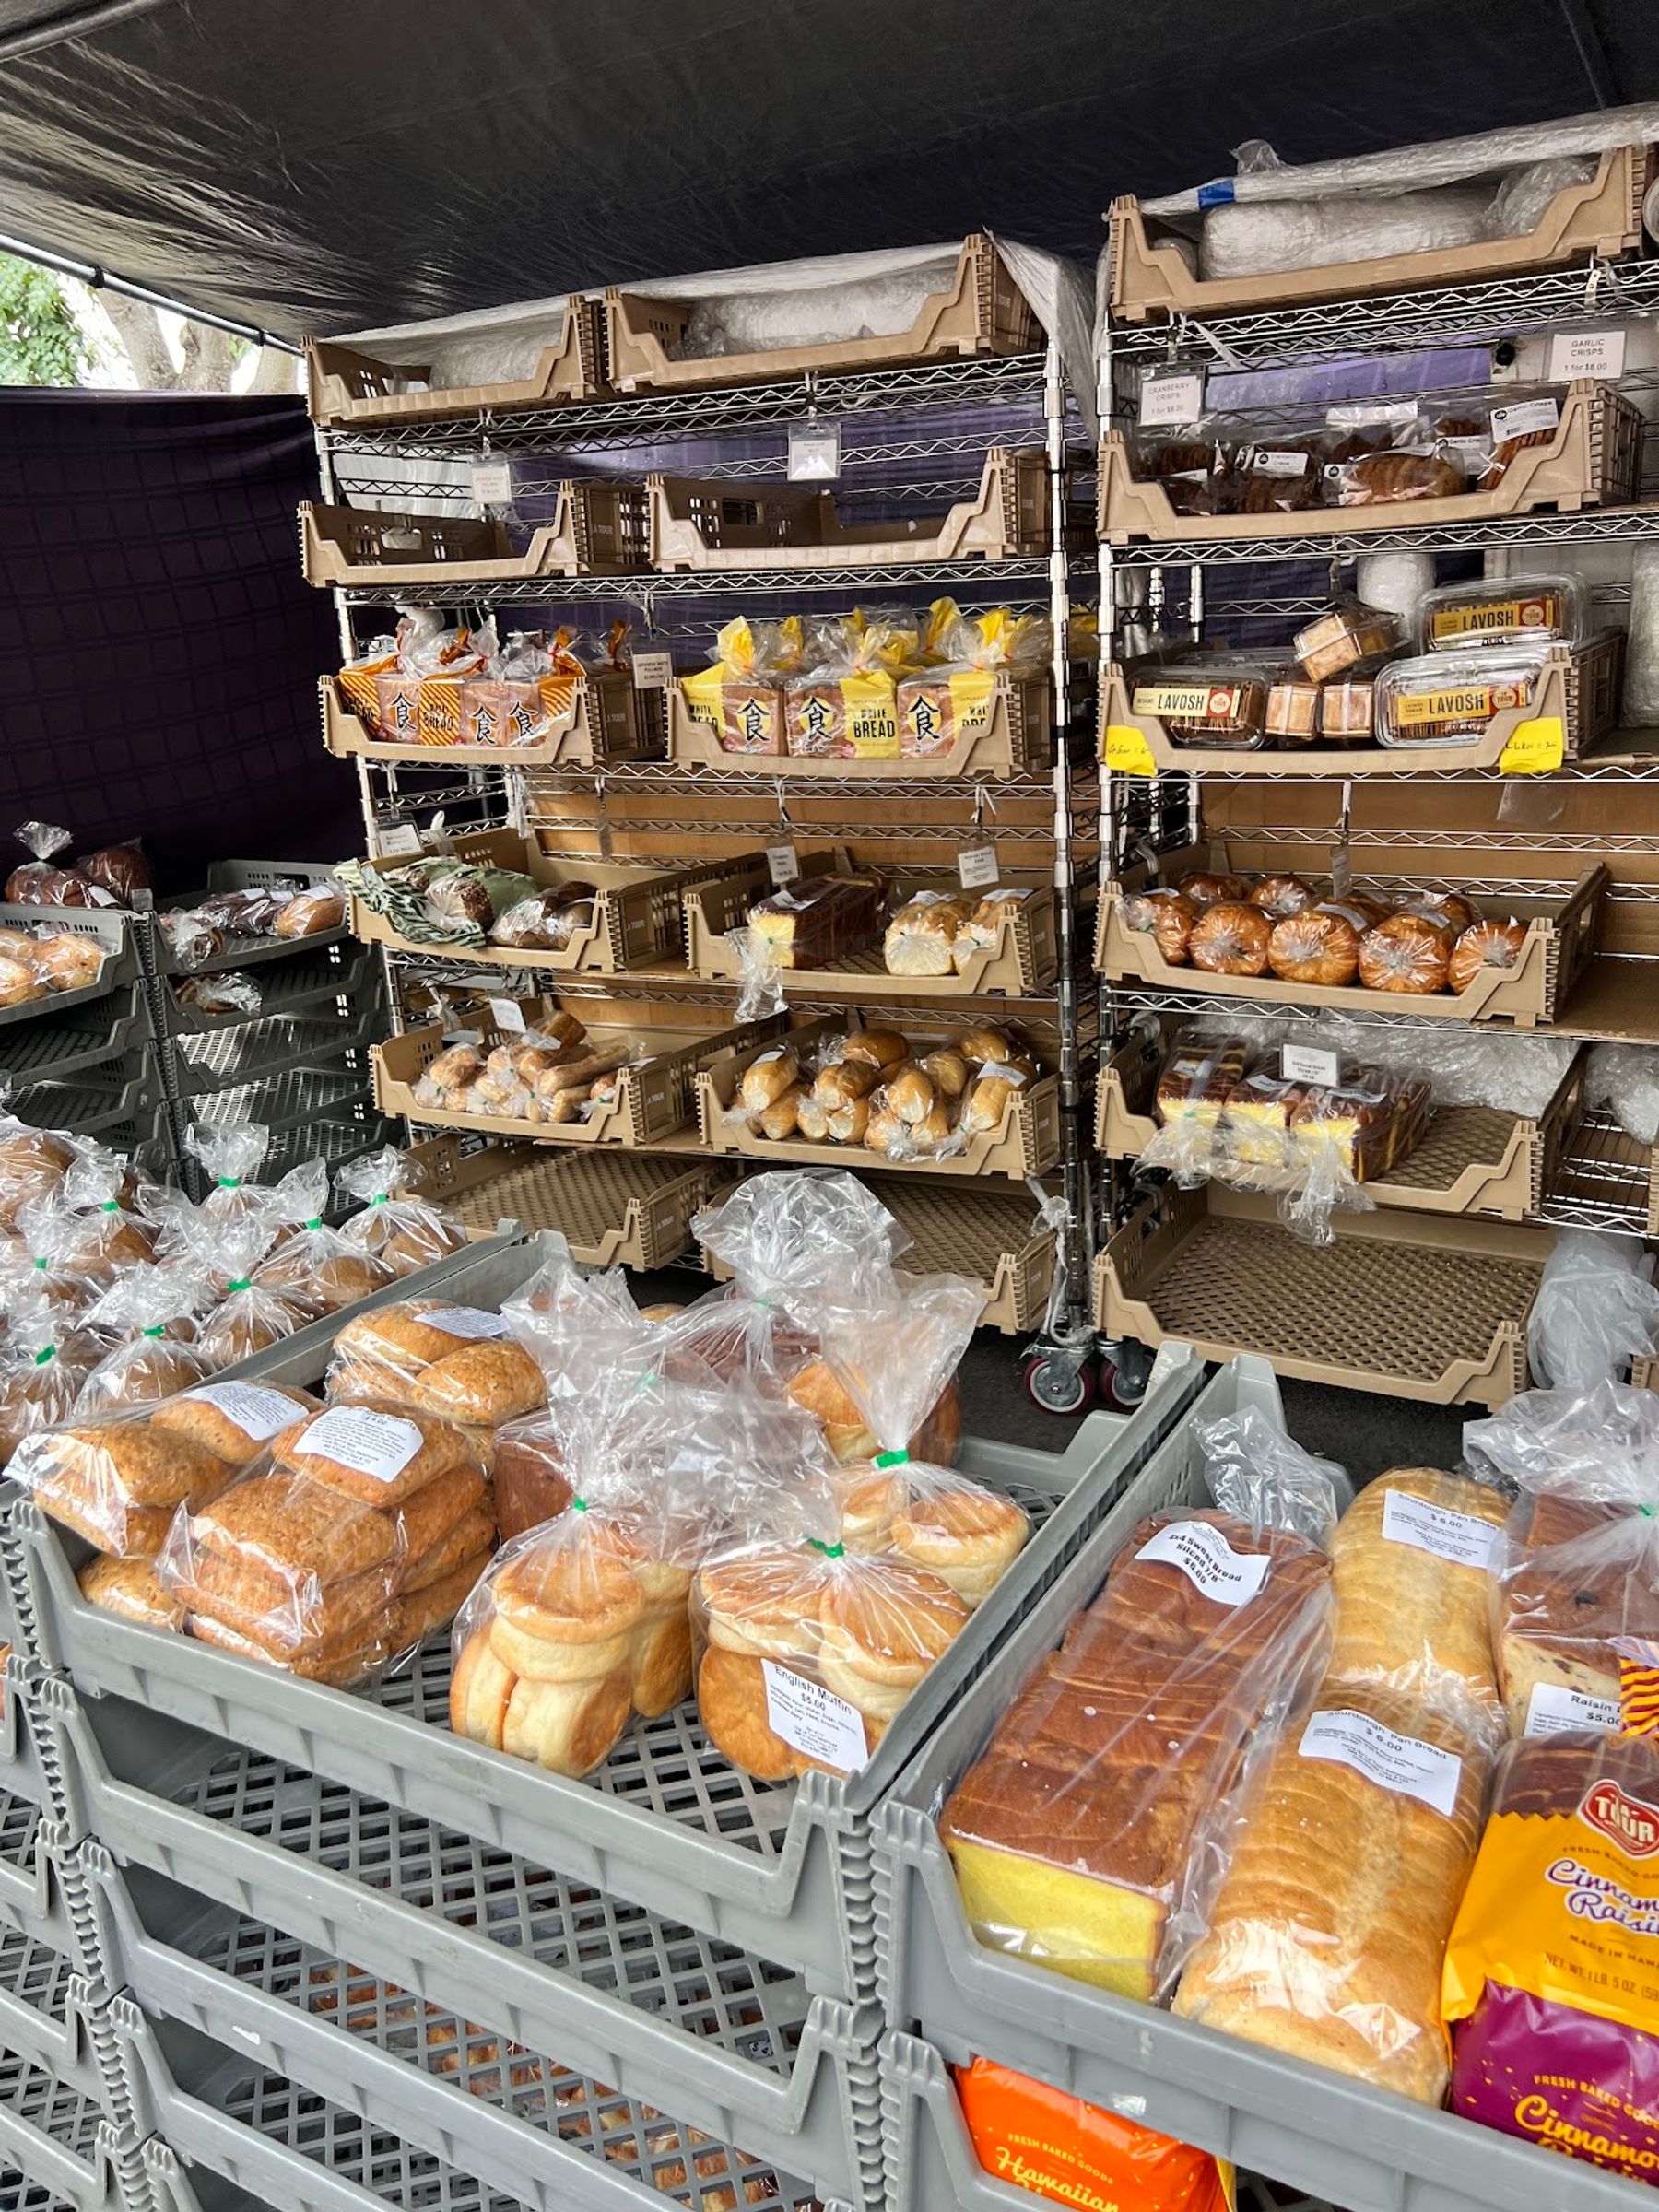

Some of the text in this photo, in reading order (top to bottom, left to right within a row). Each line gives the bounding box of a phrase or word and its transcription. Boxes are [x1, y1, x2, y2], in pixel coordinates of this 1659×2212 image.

[1571, 339, 1605, 348] GARLIC
[1571, 348, 1604, 357] CRISPS
[1148, 382, 1190, 394] CRANBERRY
[1463, 609, 1514, 631] LAVOSH
[392, 692, 417, 730] 食
[509, 700, 538, 737] 食
[737, 698, 770, 741] 食
[801, 696, 832, 739] 食
[908, 696, 940, 741] 食
[1157, 694, 1205, 711] LAVOSH
[1429, 693, 1484, 714] LAVOSH
[472, 705, 495, 745] 食
[853, 720, 895, 738] BREAD
[1398, 1492, 1446, 1516] Sourdough
[1471, 1517, 1498, 1532] Bread
[1439, 1517, 1463, 1529] 6.00
[1175, 1543, 1206, 1568] Sliced
[1187, 1536, 1213, 1566] Sweet
[1212, 1561, 1242, 1583] Bread
[775, 1665, 815, 1695] English
[818, 1688, 853, 1716] Muffin
[801, 1691, 827, 1712] $5.00
[1571, 1694, 1613, 1712] Raisin
[1327, 1711, 1447, 1759] Sourdough Pan Bread
[1376, 1735, 1403, 1752] 6.00
[1547, 1858, 1659, 1912] Cinnam
[1546, 1951, 1564, 1968] NET
[1569, 1935, 1605, 1955] MADE
[1627, 1952, 1659, 1969] HAW
[1534, 2074, 1576, 2089] FRESH
[1580, 2081, 1620, 2109] BAKED
[1007, 2133, 1114, 2185] FRESH BAKED GOODS
[995, 2146, 1119, 2212] Hawaiian
